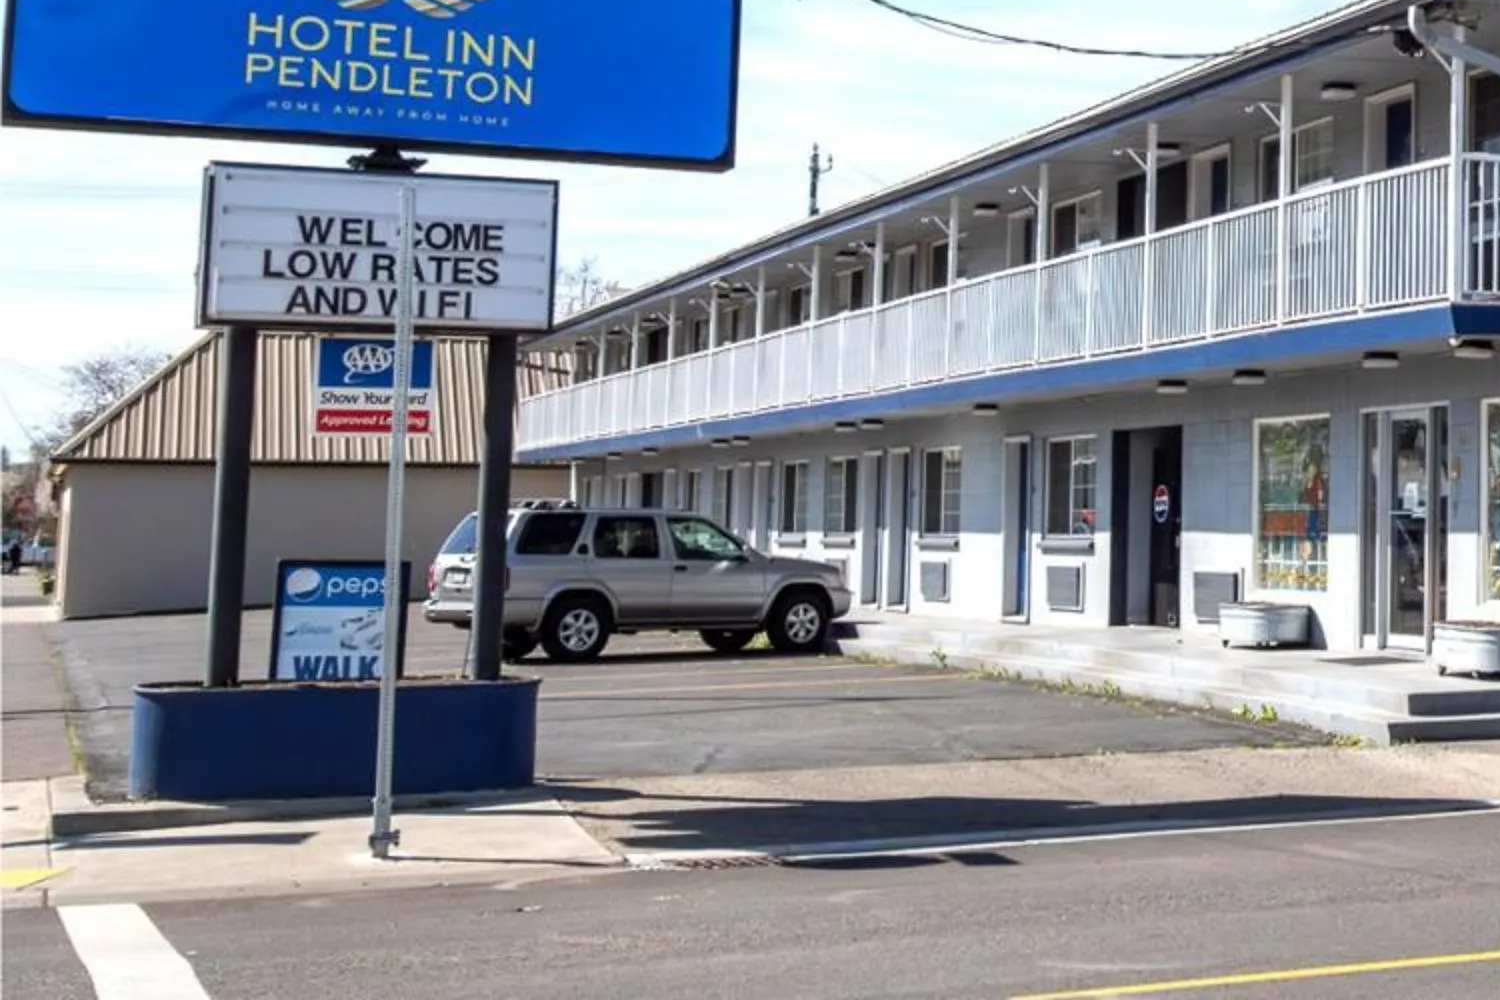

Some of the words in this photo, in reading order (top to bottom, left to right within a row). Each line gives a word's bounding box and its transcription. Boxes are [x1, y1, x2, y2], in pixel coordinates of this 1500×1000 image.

[248, 12, 430, 61] HOTEL
[446, 29, 535, 70] INN
[245, 53, 533, 105] PENDLETON
[266, 100, 321, 113] HOME
[333, 104, 386, 118] AWAY
[397, 109, 447, 122] FROM
[459, 114, 509, 127] HOME
[263, 249, 357, 280] LOW
[285, 285, 368, 315] AND
[345, 345, 392, 374] AAA
[320, 391, 359, 405] Show
[363, 391, 392, 405] Your
[320, 413, 377, 427] Approved
